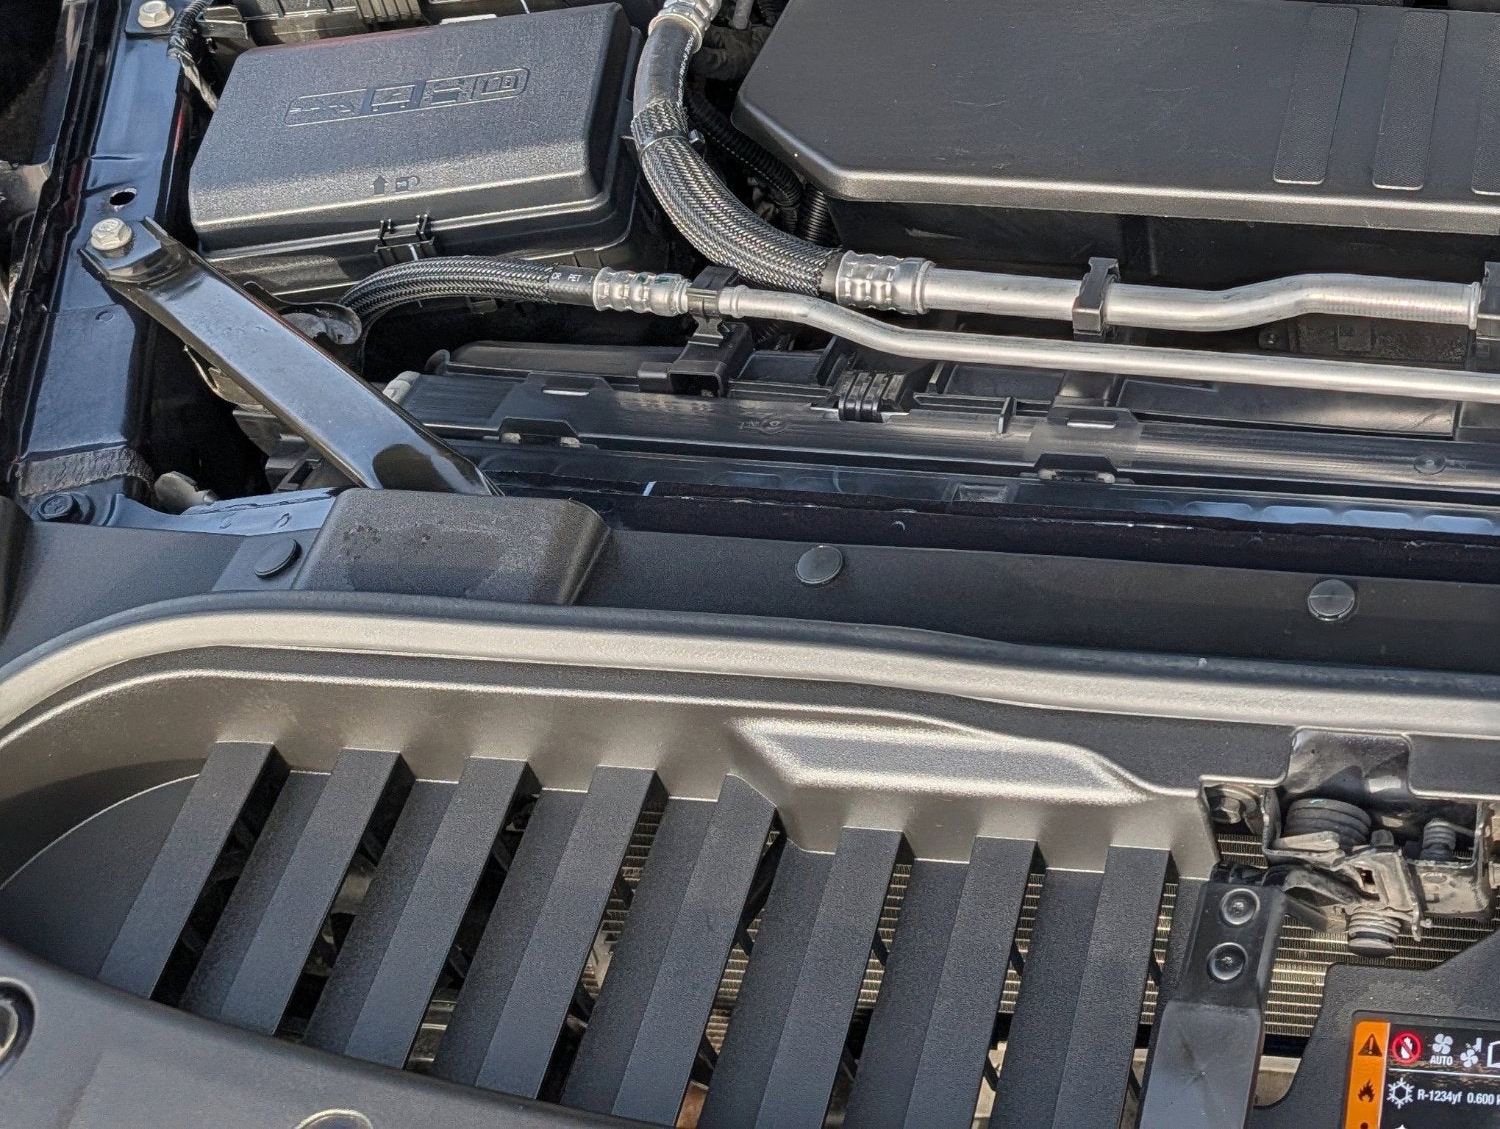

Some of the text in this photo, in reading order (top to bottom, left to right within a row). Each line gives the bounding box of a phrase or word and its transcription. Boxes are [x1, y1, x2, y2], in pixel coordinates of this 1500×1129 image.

[1430, 1055, 1453, 1066] AUTO
[1417, 1088, 1463, 1105] R-1234yf
[1467, 1092, 1495, 1105] 0.600
